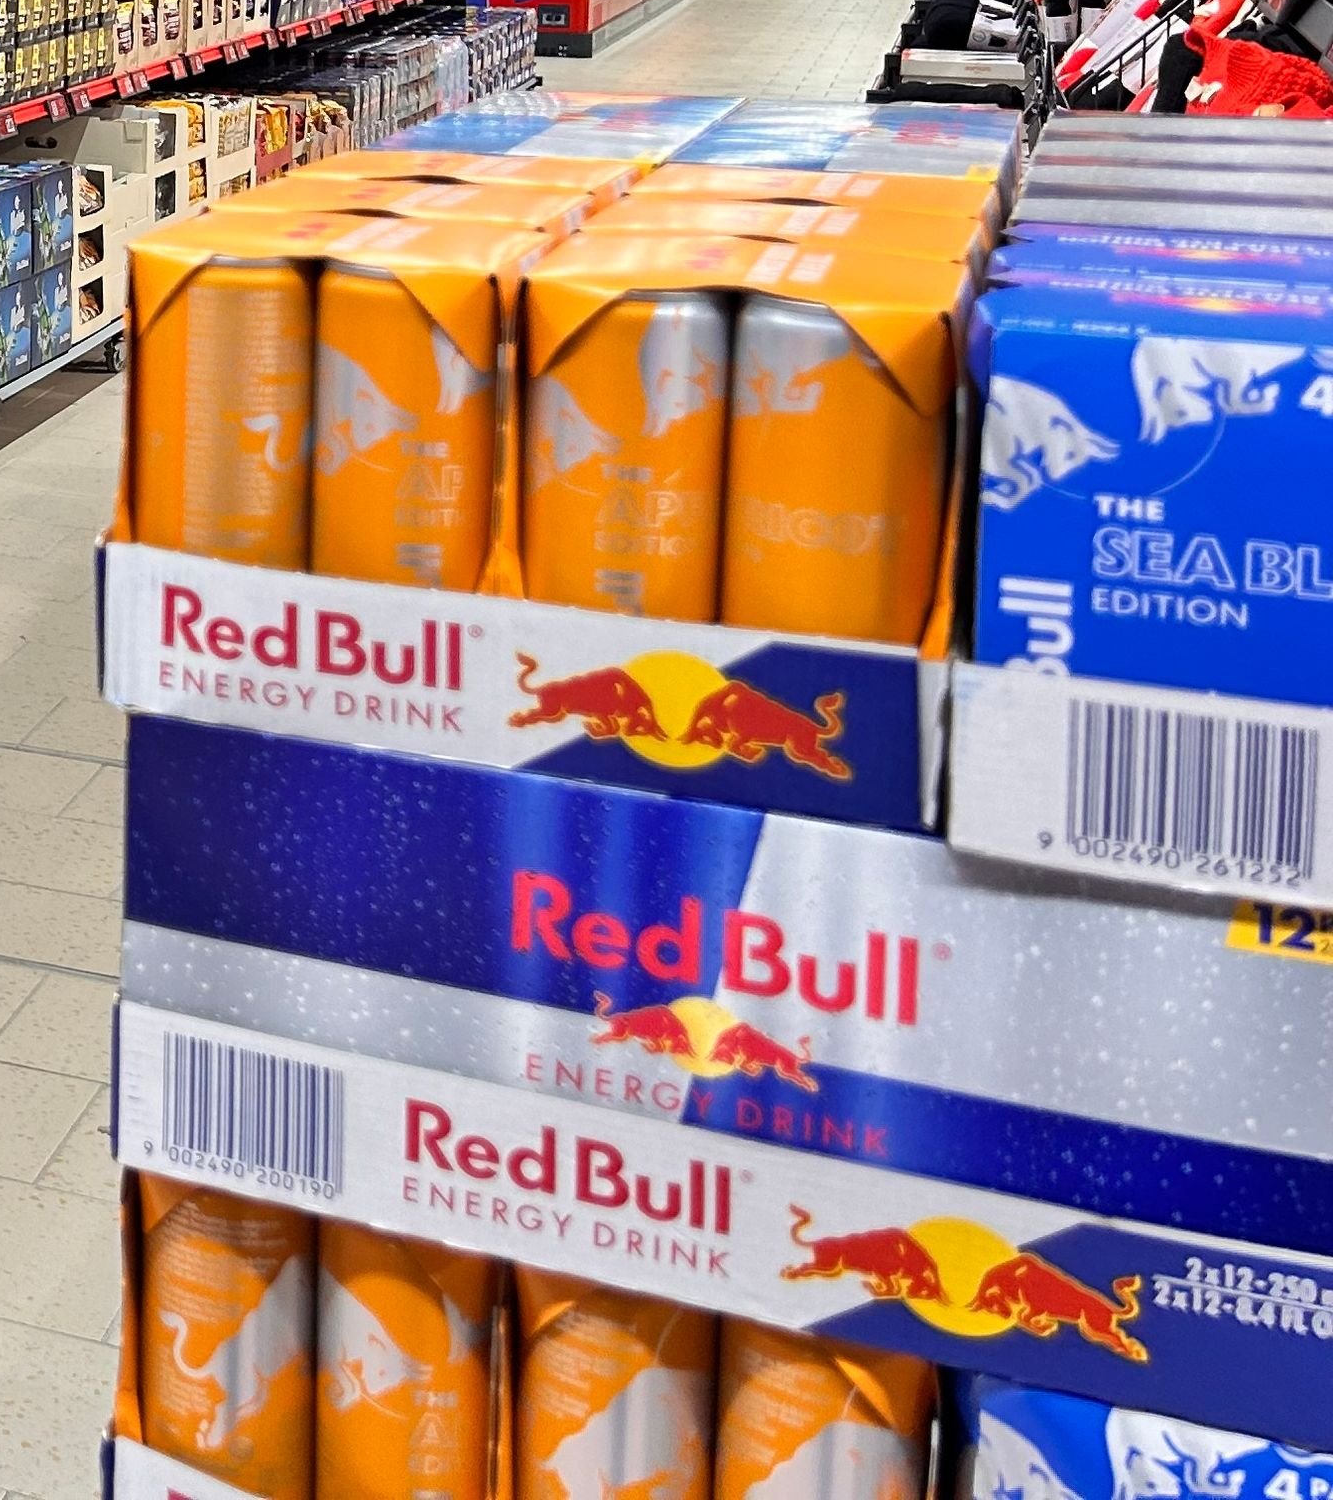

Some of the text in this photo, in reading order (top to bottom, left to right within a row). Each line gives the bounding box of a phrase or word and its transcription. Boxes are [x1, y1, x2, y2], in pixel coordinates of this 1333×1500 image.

[1093, 493, 1166, 523] THE
[1091, 524, 1235, 592] SEA
[159, 582, 463, 691] Red Bull
[1091, 586, 1250, 631] EDITION
[158, 662, 464, 734] ENERGY DRINK
[1037, 831, 1303, 888] 9 002490 261252
[510, 868, 920, 1027] Red Bull
[1252, 902, 1315, 953] 12
[526, 1052, 890, 1159] ENERGY DRINK
[143, 1141, 336, 1202] 9 002490 200190
[403, 1096, 733, 1235] Red Bull
[403, 1177, 732, 1279] ENERGY DRINK
